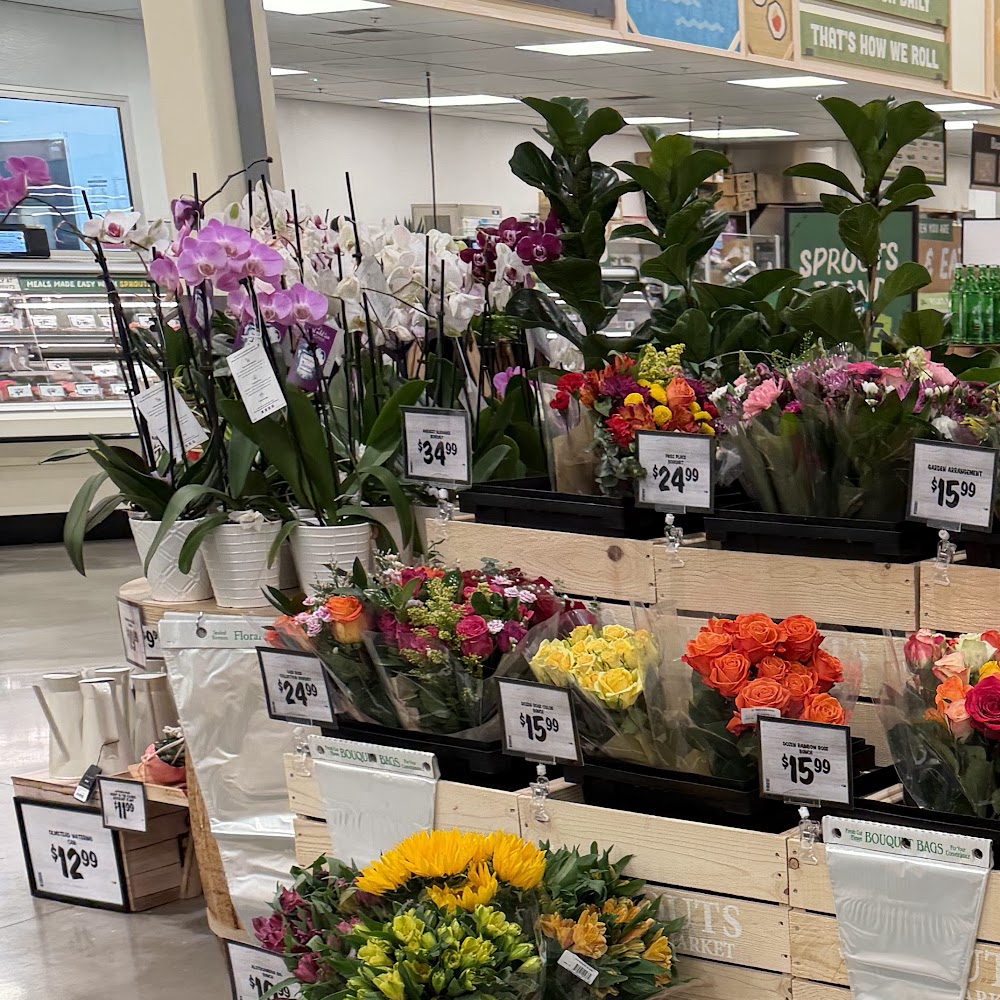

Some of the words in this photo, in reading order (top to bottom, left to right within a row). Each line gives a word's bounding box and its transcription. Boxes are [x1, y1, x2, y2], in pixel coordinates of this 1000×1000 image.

[810, 24, 857, 53] THAT'S
[860, 34, 886, 59] HOW
[890, 40, 908, 63] WE
[911, 46, 939, 69] ROLL
[799, 242, 899, 278] SPROS
[948, 467, 982, 477] ARRANGEMENT
[234, 630, 262, 641] Flora
[340, 748, 377, 763] BOUQU
[380, 755, 401, 767] BAGS
[865, 831, 914, 850] BOUQU
[917, 839, 943, 855] BAGS
[675, 936, 737, 959] ARKET
